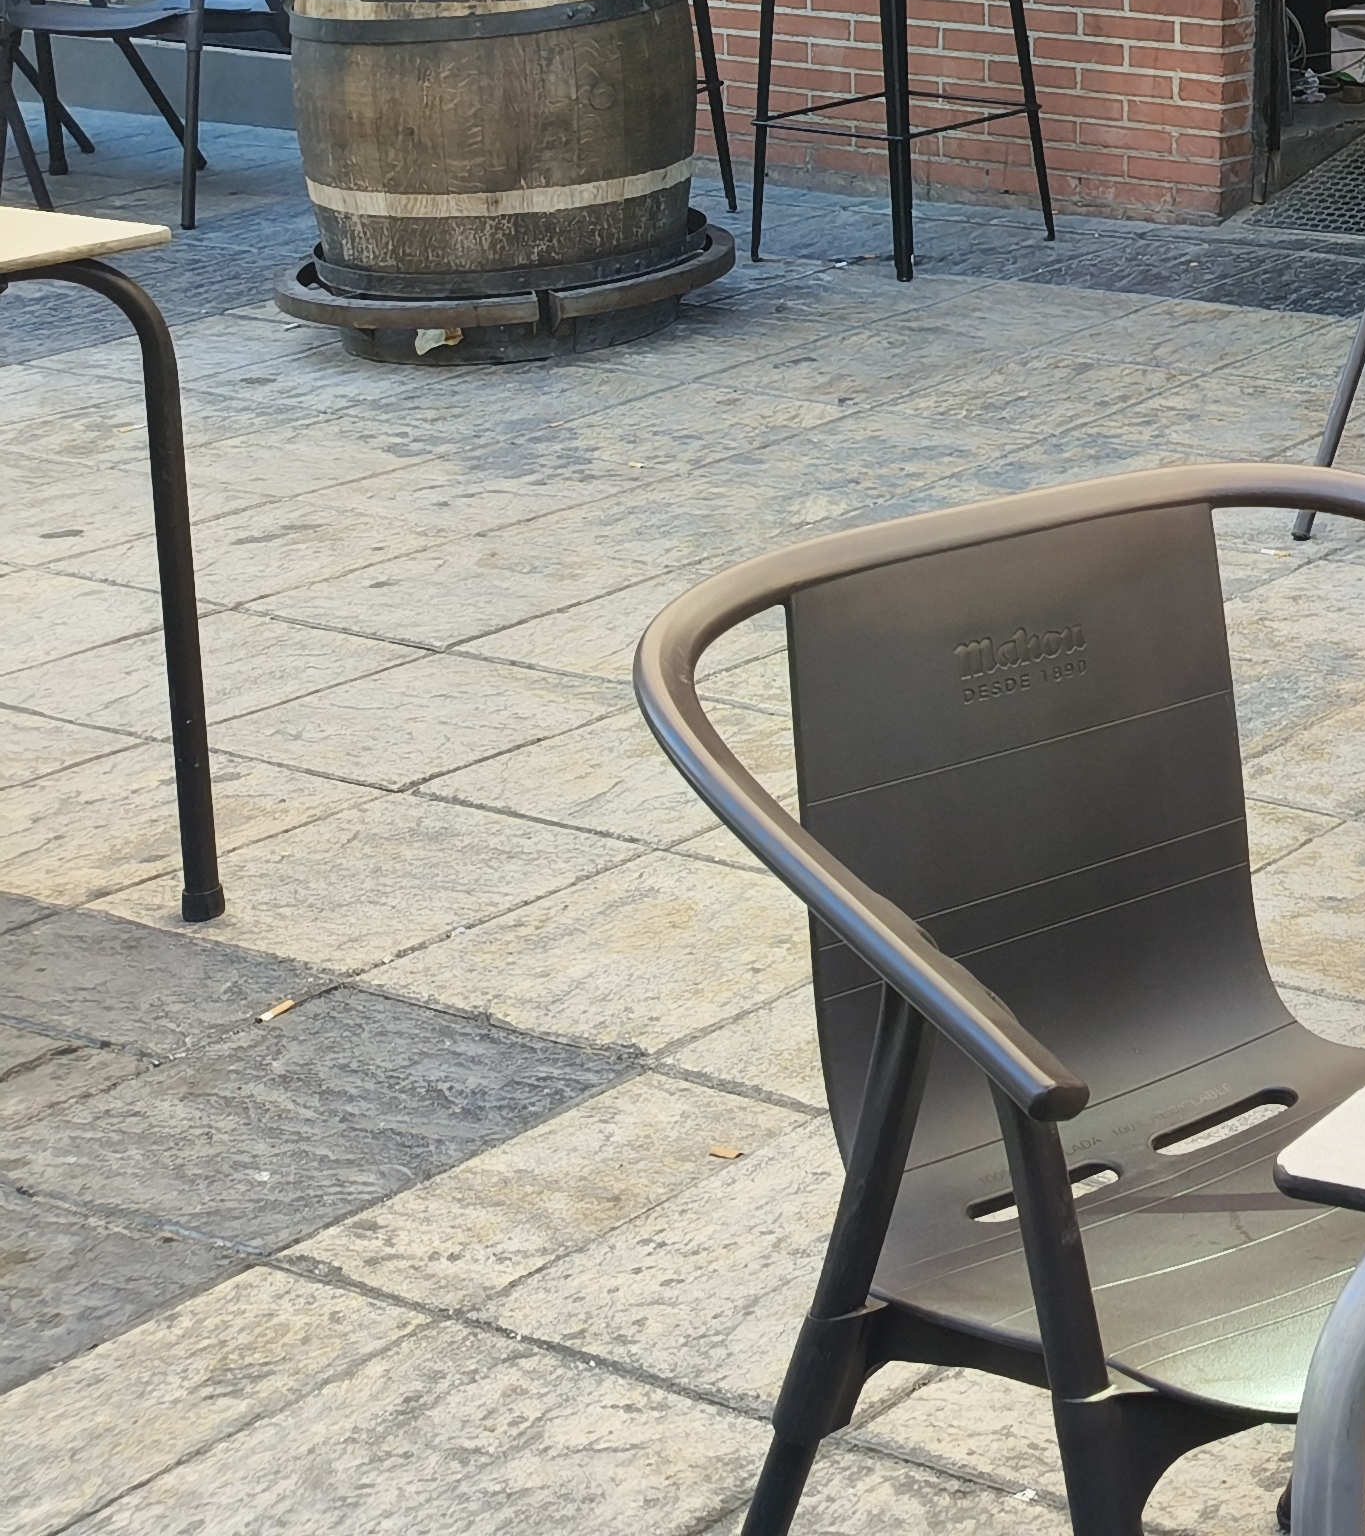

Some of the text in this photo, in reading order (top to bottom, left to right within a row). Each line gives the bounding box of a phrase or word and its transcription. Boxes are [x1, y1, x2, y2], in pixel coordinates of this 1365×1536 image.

[954, 624, 1087, 680] Mahou
[964, 659, 1087, 705] DESDE 1890
